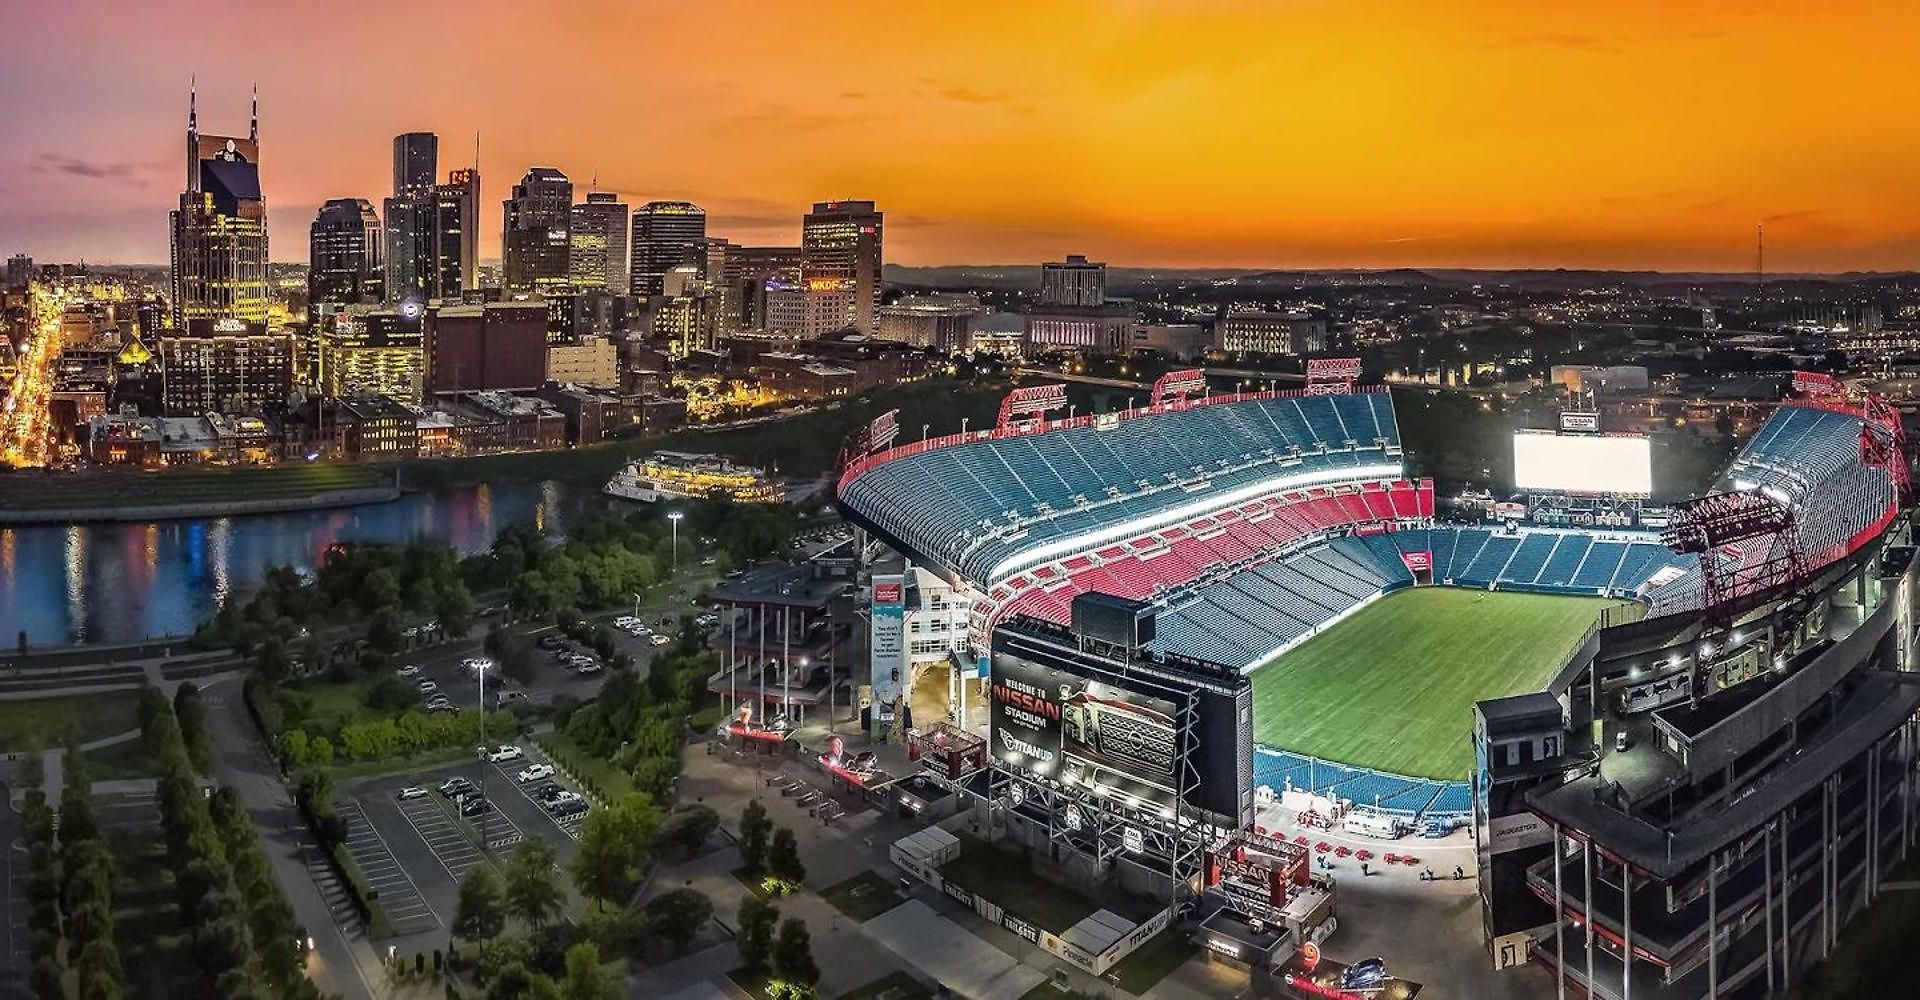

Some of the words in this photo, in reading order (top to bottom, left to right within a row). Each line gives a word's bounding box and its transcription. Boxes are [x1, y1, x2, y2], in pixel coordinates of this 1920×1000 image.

[810, 280, 838, 292] WKDF
[1005, 678, 1036, 696] WELCOME
[1037, 688, 1046, 699] TO
[993, 684, 1060, 721] NISSAN
[1005, 706, 1046, 728] STADIUM
[1213, 855, 1270, 884] NISSAN
